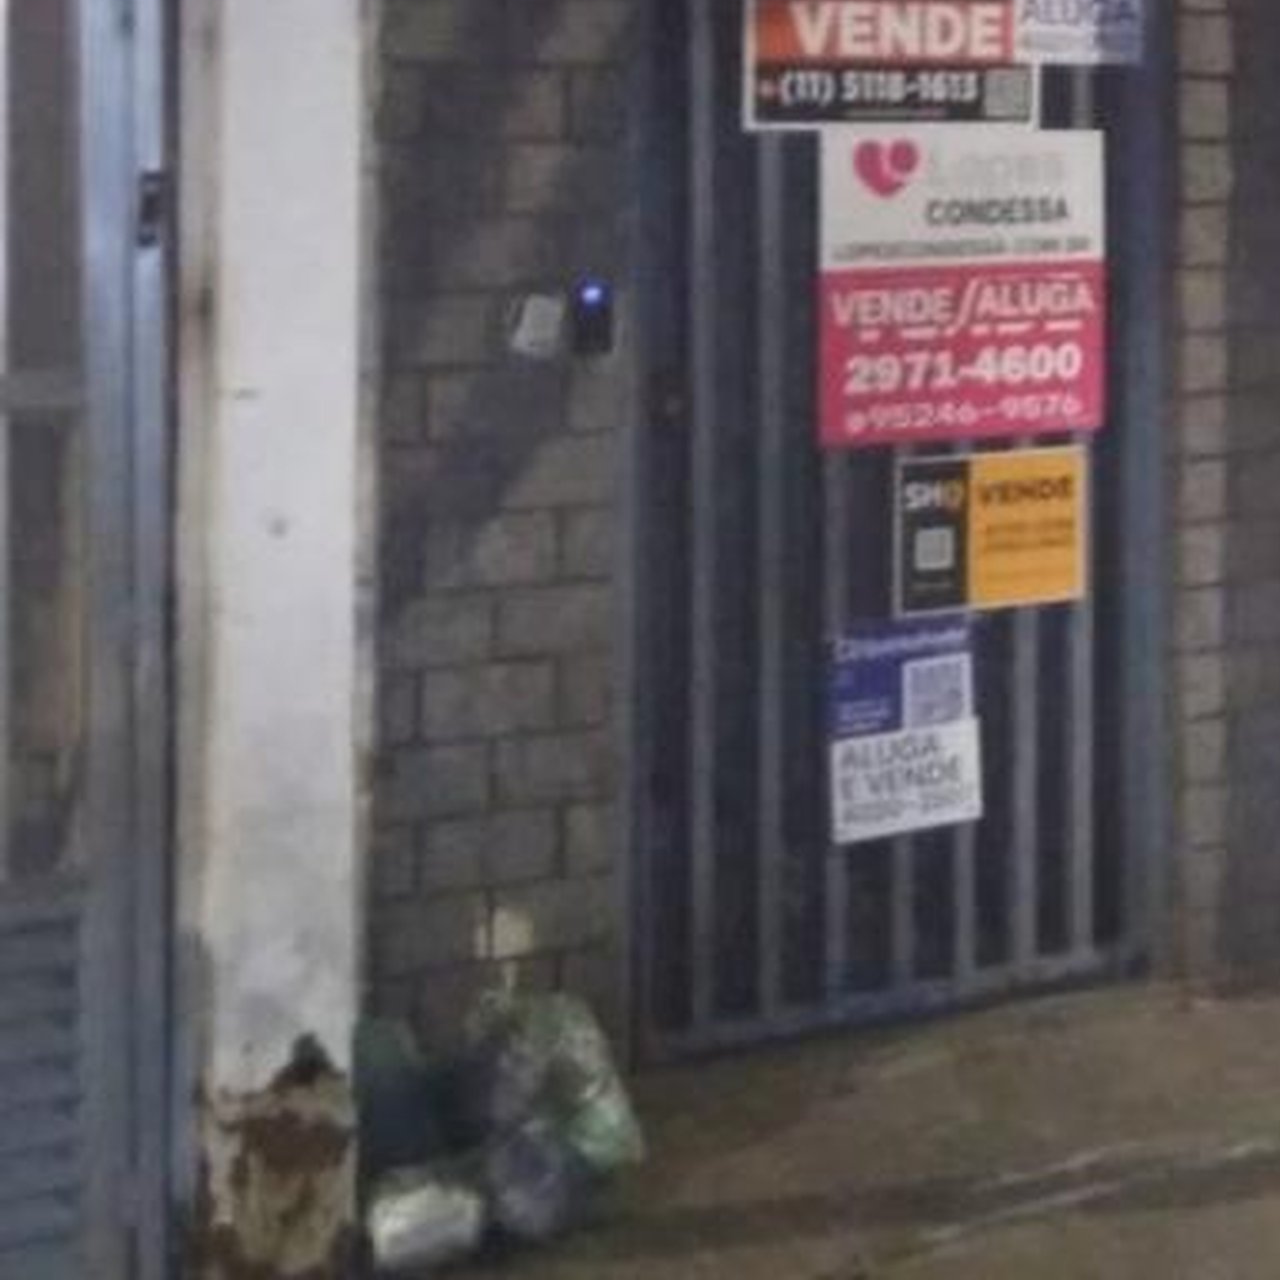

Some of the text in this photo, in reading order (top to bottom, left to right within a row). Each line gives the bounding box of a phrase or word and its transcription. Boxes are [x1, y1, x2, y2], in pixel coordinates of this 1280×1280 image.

[788, 0, 1000, 58] VENDE
[926, 195, 1068, 226] CONDESSA
[844, 342, 1082, 395] 2971-4600
